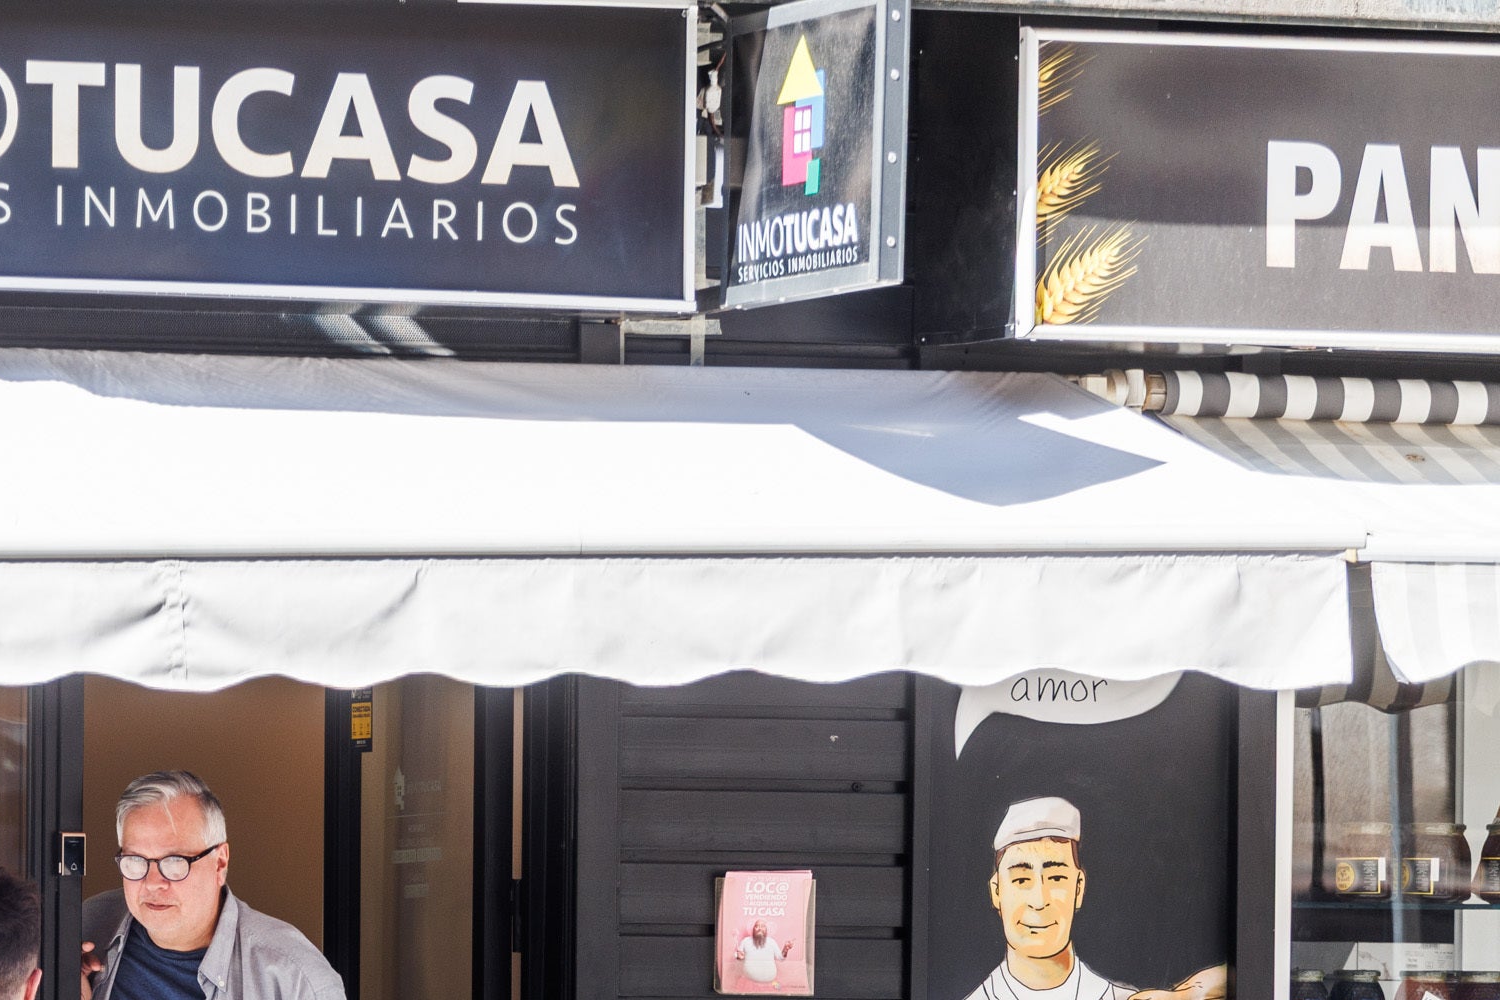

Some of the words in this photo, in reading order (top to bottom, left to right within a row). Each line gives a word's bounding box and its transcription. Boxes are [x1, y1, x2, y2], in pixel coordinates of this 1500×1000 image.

[55, 184, 579, 247] INMOBILIARIOS
[1265, 140, 1500, 274] PAN
[738, 202, 858, 264] INMOTUCASA
[738, 259, 785, 283] SERVICIOS
[788, 246, 858, 274] INMOBILIARIOS
[1010, 676, 1108, 702] amor
[745, 881, 790, 894] LOC@
[742, 907, 757, 916] TU
[758, 907, 785, 916] CASA
